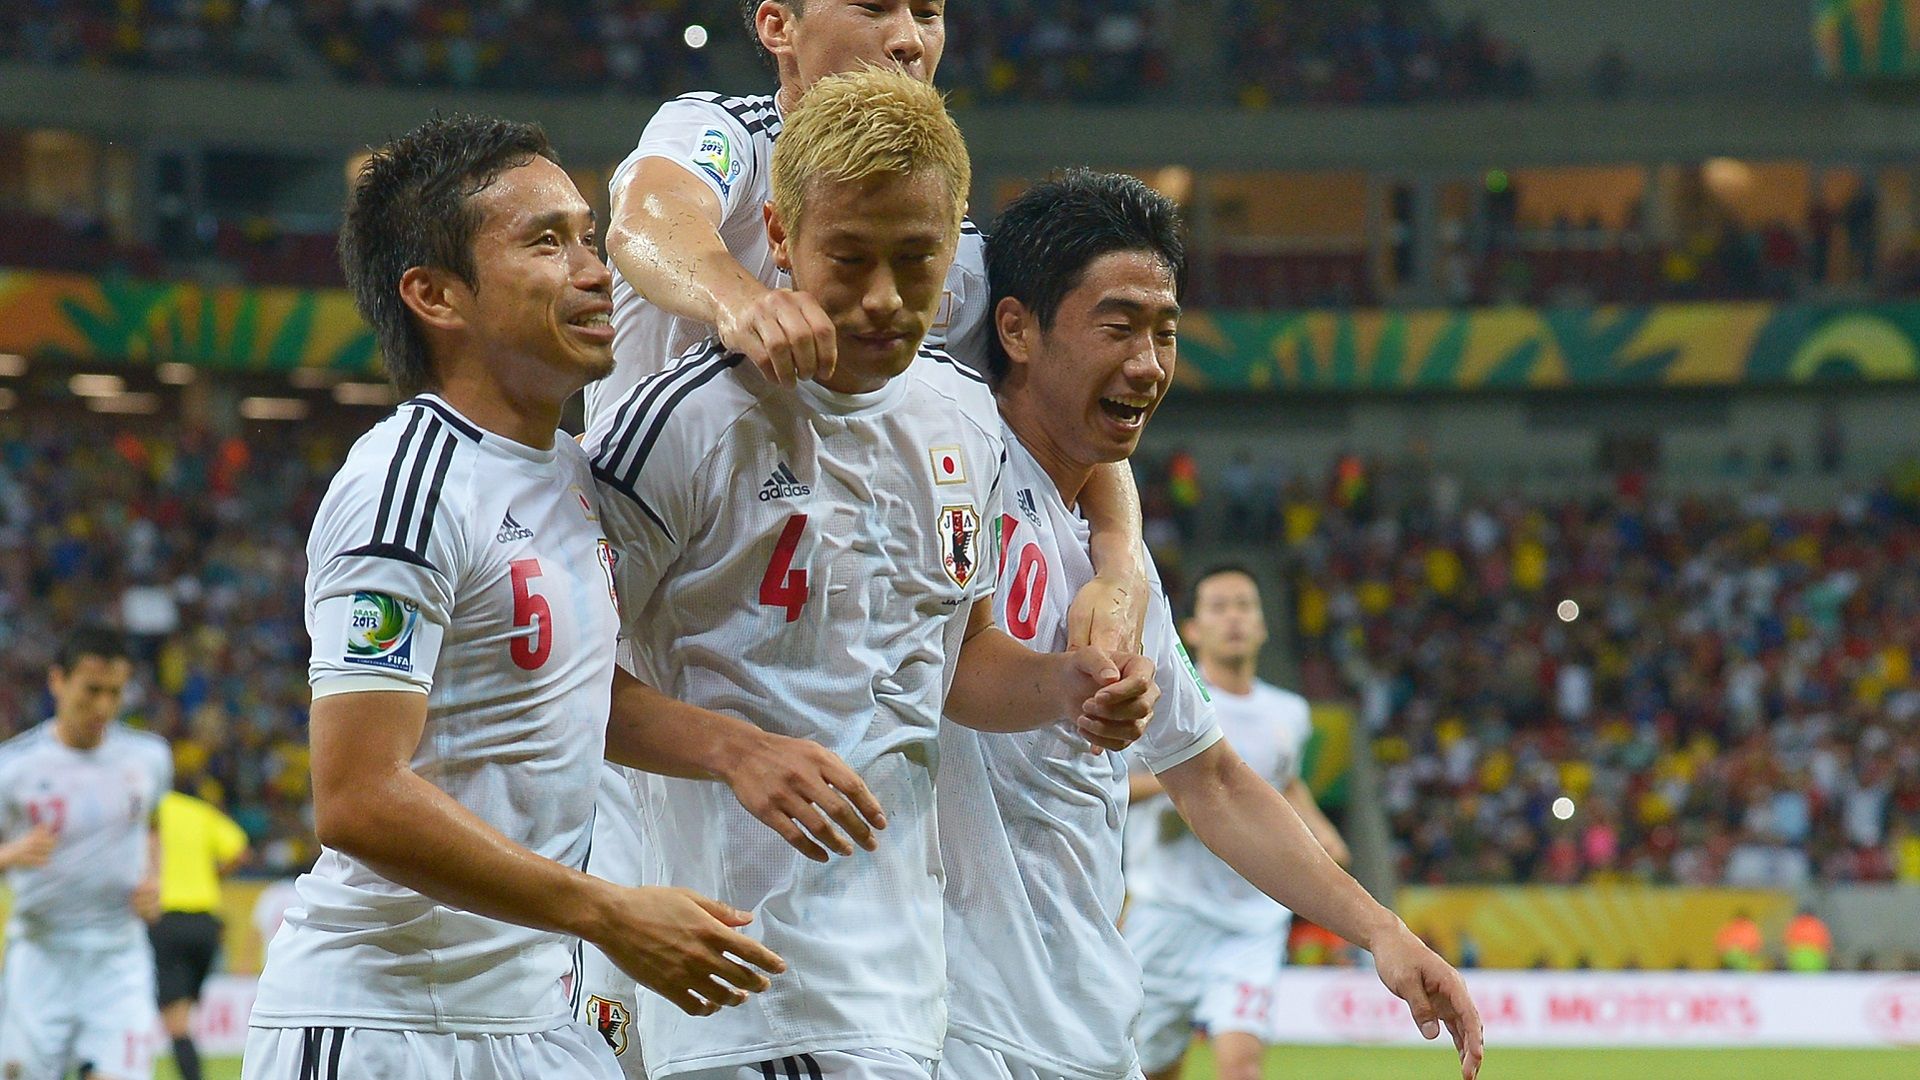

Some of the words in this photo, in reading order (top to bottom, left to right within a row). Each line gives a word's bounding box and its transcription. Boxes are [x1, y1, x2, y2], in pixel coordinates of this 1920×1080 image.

[758, 483, 811, 501] adidas
[496, 527, 534, 544] adidas
[759, 513, 810, 623] 4
[352, 615, 377, 628] 2013
[509, 557, 552, 671] 5
[387, 655, 409, 666] FIFA
